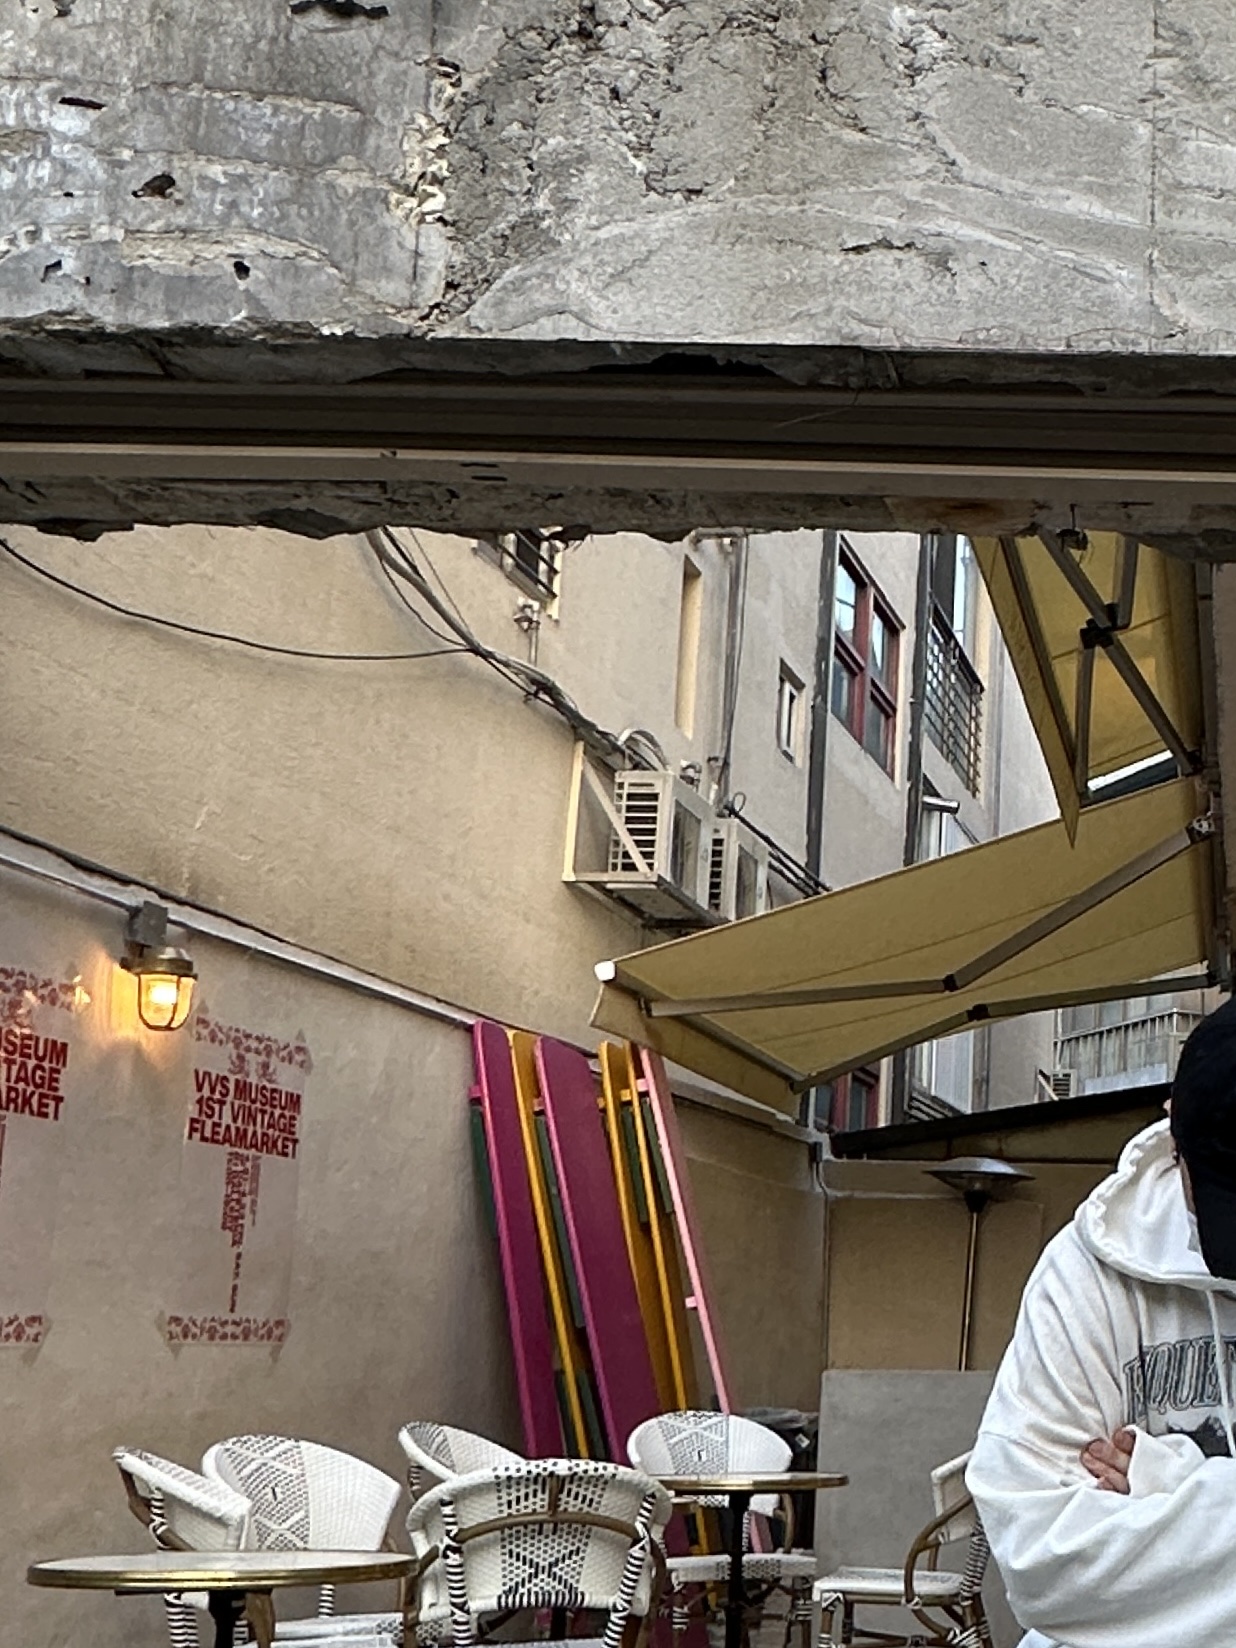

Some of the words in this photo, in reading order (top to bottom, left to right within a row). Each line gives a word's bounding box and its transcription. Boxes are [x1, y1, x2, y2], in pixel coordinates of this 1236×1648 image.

[0, 1025, 69, 1069] SEUM
[0, 1057, 62, 1093] TAGE
[194, 1068, 230, 1099] VVS
[233, 1078, 301, 1116] MUSEUM
[196, 1095, 227, 1121] 1ST
[231, 1101, 298, 1136] VINTAGE
[187, 1116, 299, 1159] FLEAMARKET
